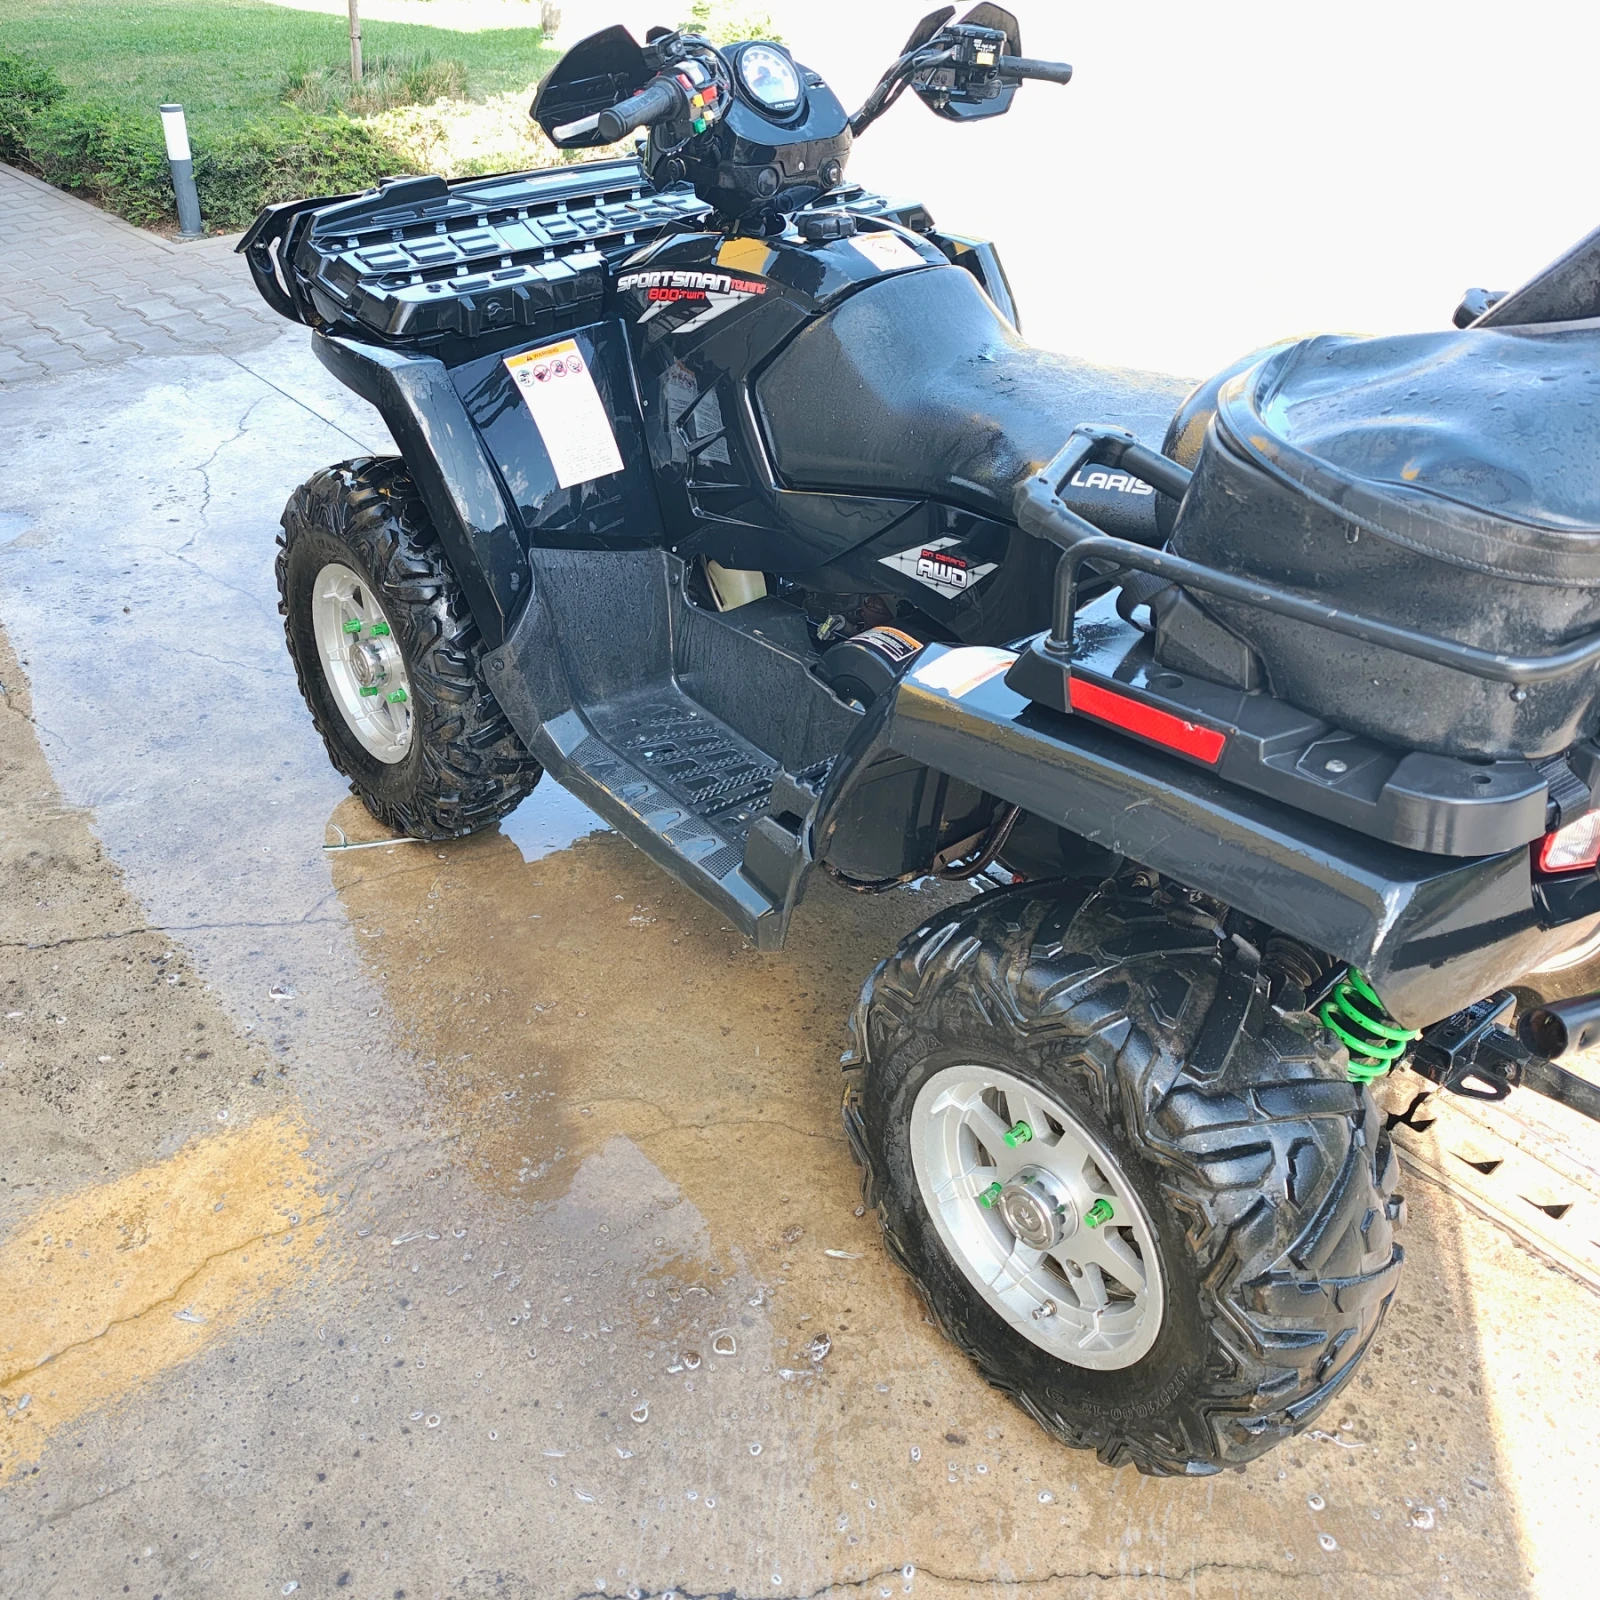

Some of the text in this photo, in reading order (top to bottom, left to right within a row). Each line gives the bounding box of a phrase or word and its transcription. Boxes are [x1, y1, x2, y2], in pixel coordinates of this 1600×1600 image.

[616, 271, 766, 295] SPORTSMAN TOURING
[648, 288, 680, 301] 800
[533, 347, 559, 360] WARNING
[936, 554, 966, 568] DEMAND
[917, 558, 968, 588] AWD
